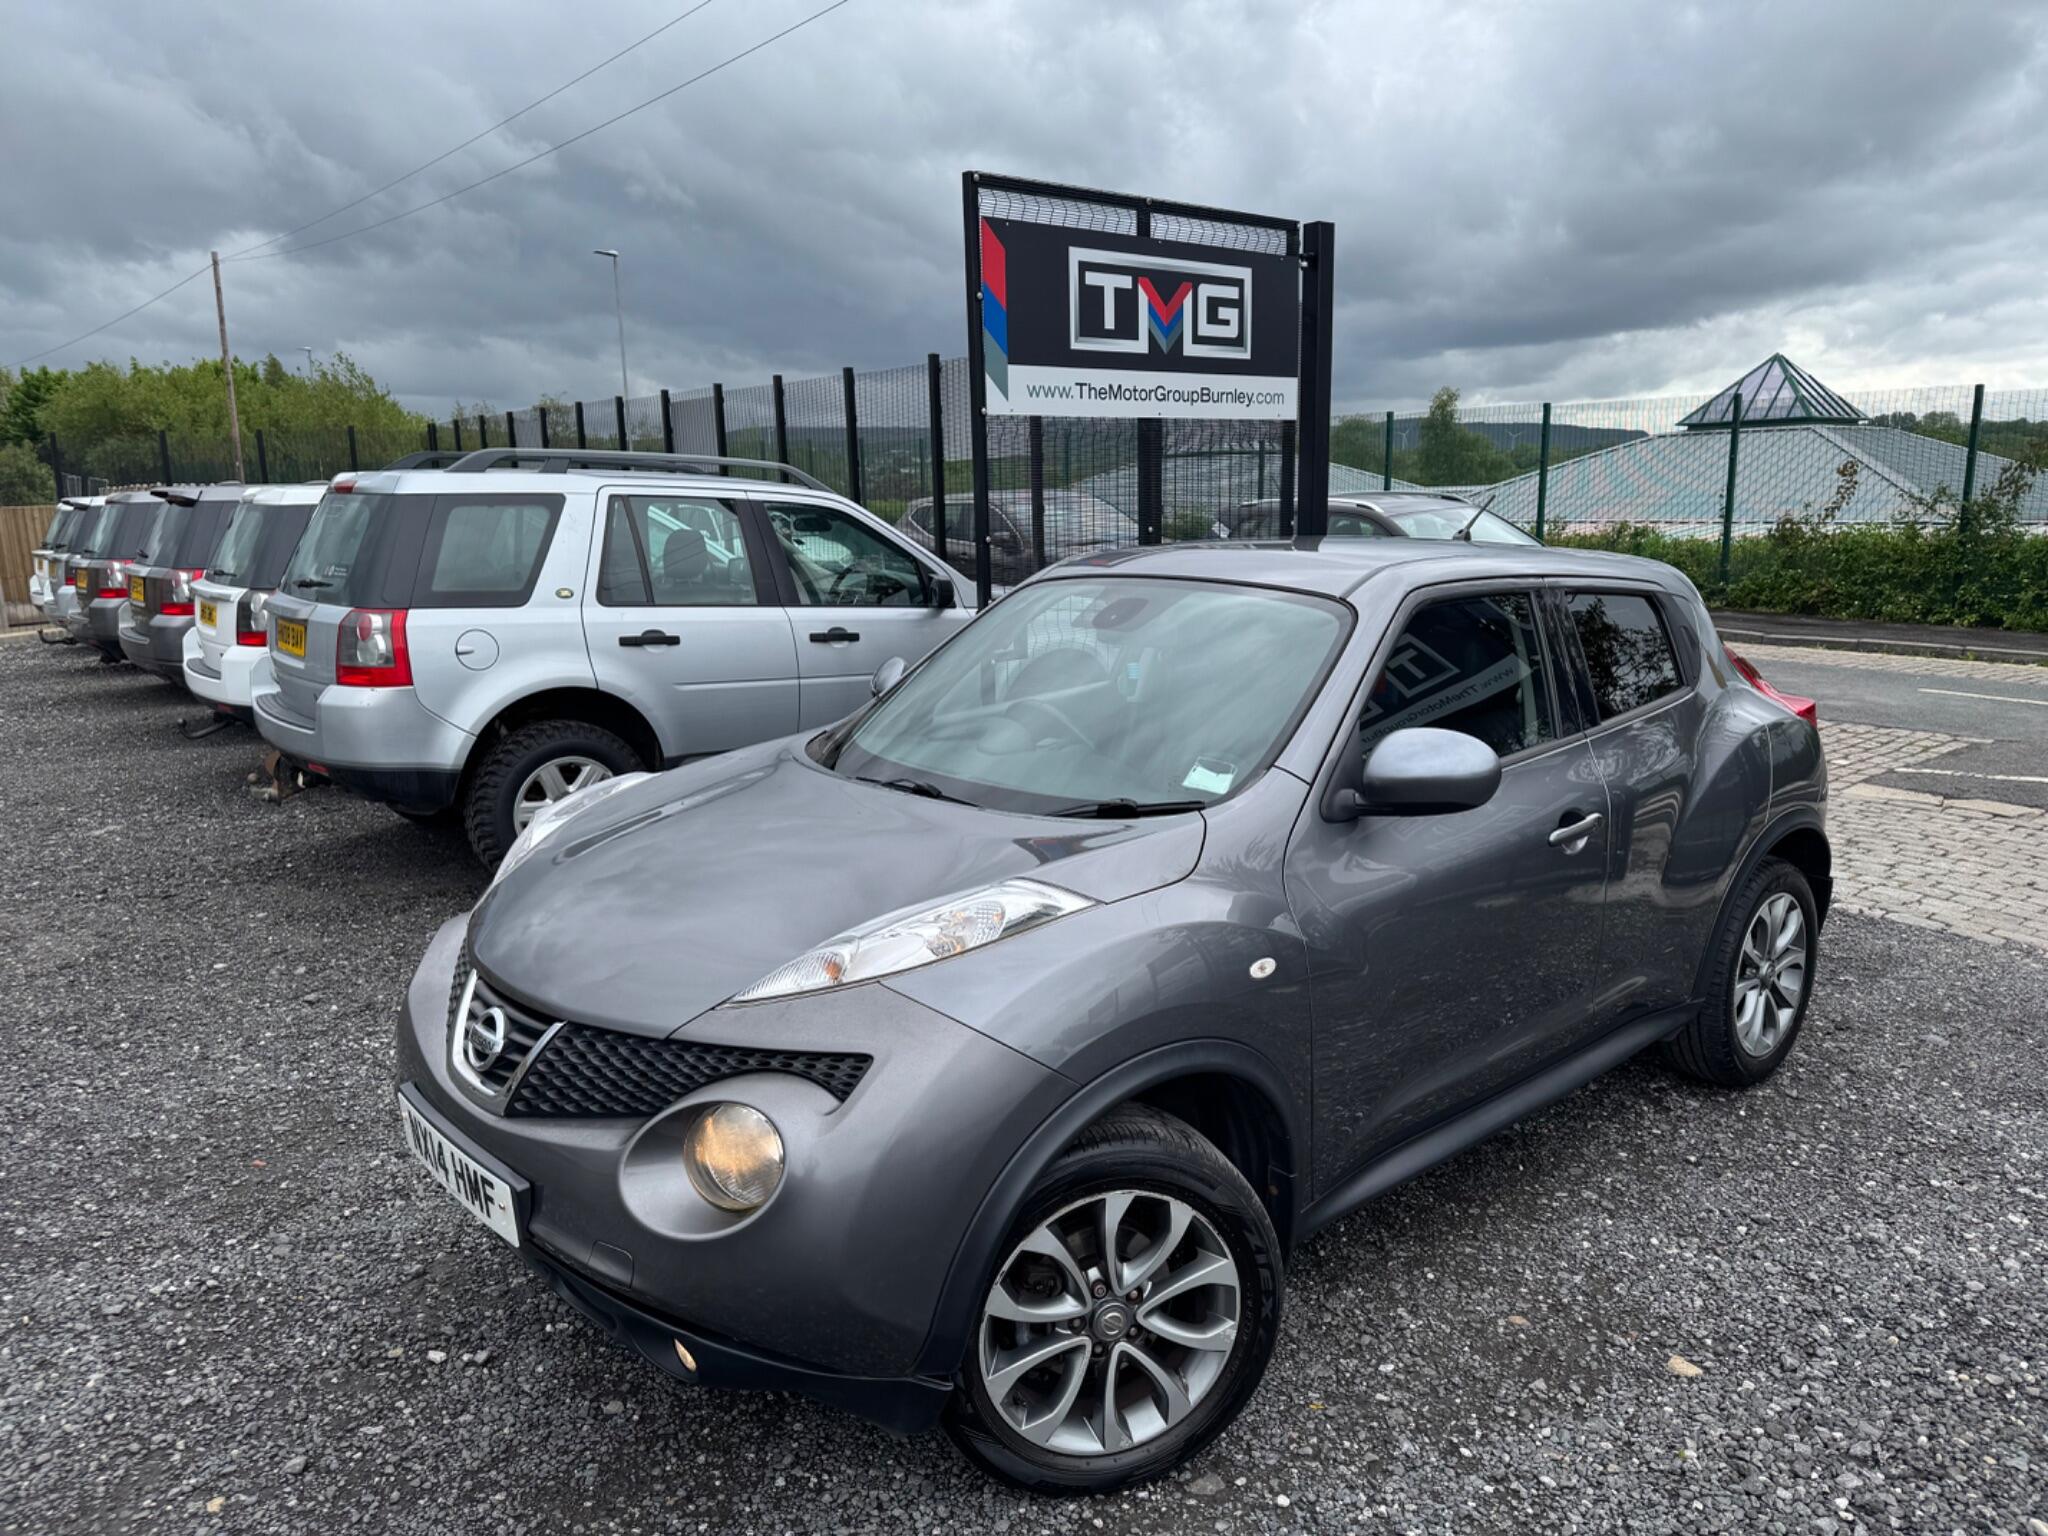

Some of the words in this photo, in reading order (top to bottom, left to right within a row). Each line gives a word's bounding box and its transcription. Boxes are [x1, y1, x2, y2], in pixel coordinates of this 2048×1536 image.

[1085, 270, 1239, 354] TMG
[1027, 382, 1285, 408] www.TheMotorGroupBurnley.com
[408, 1109, 450, 1183] NX14
[451, 1151, 495, 1218] HMF
